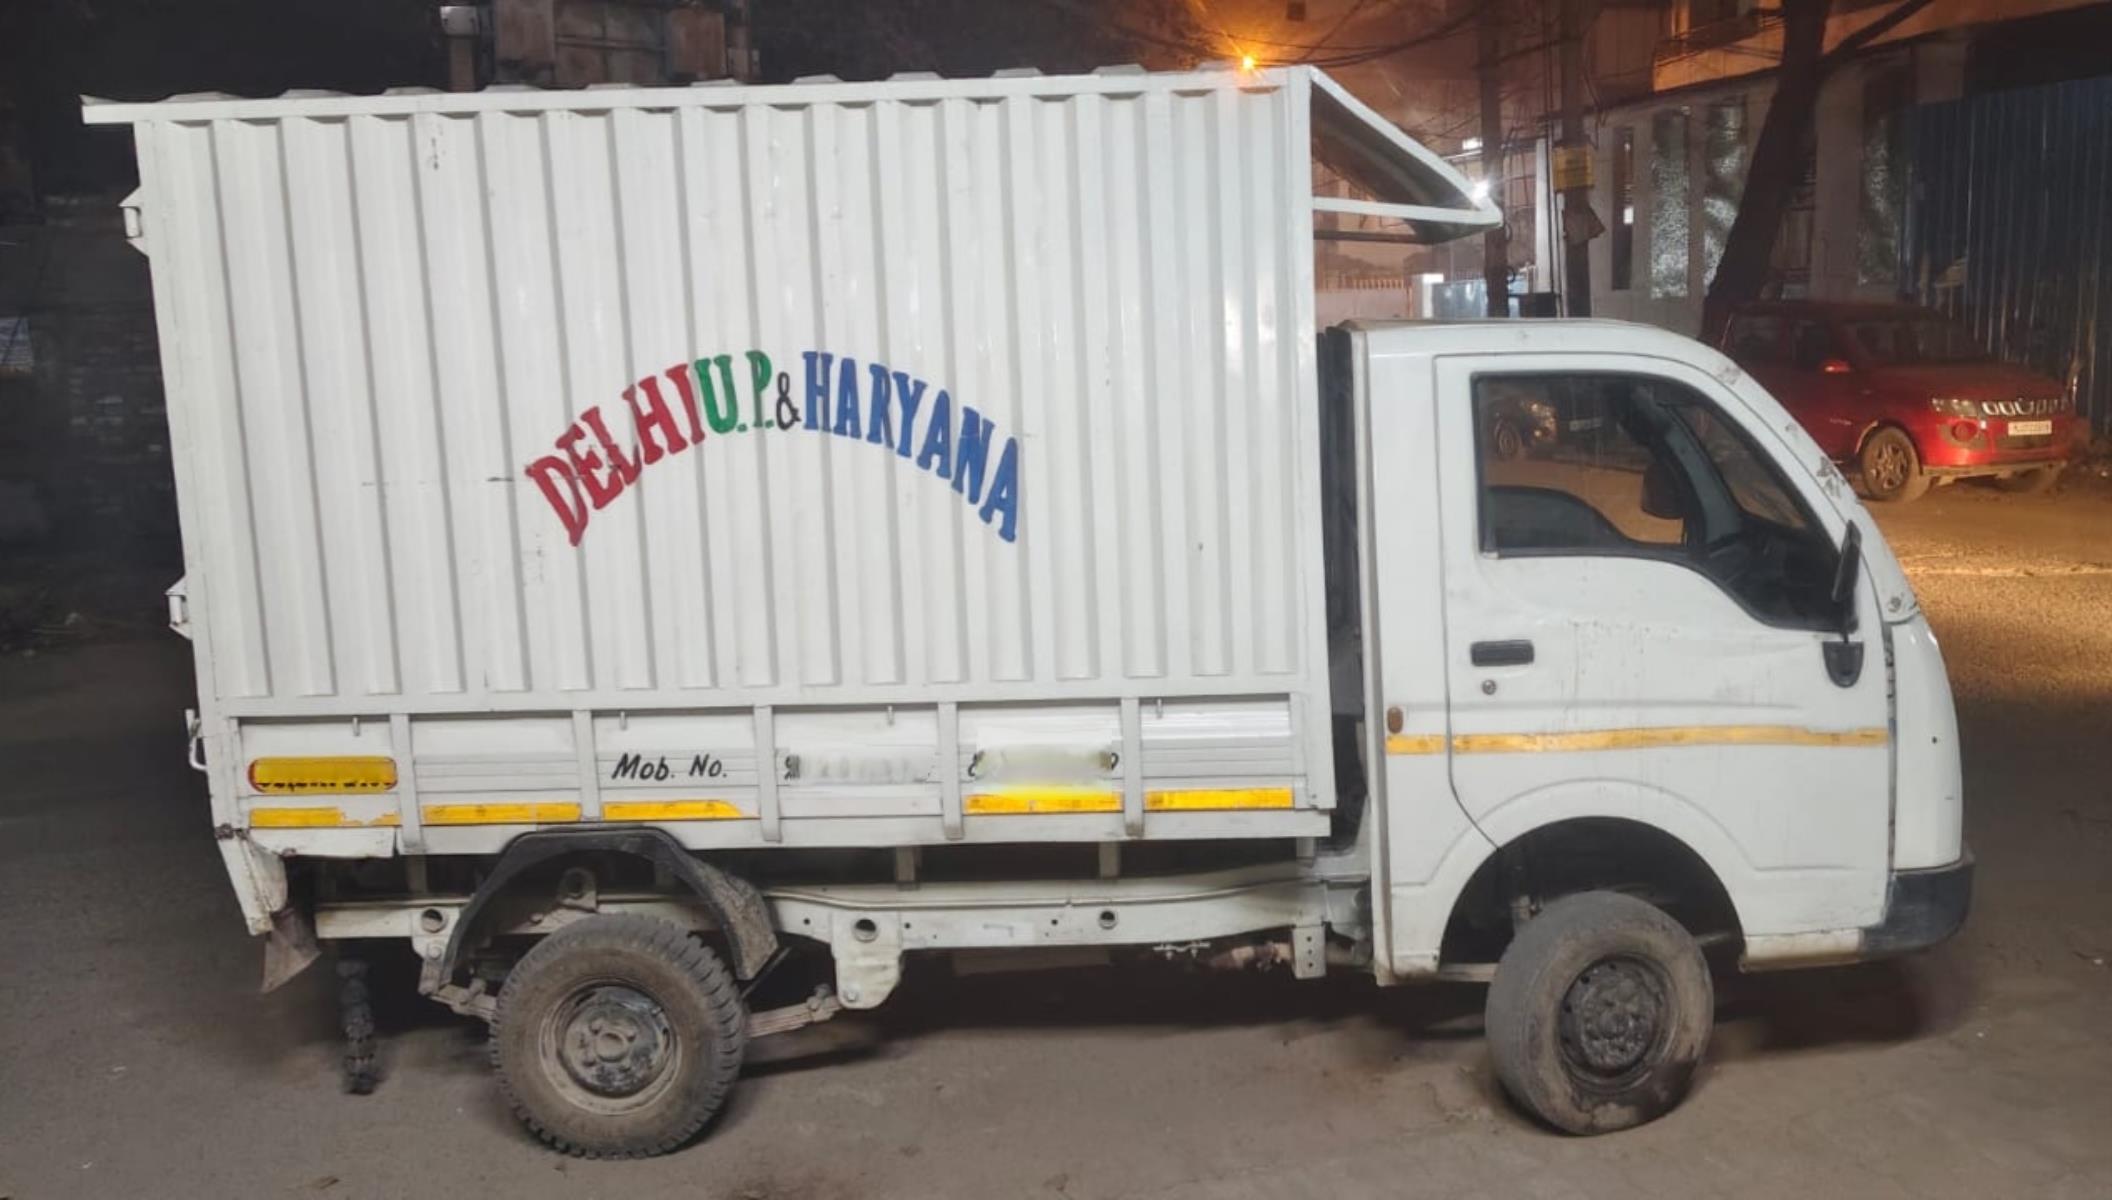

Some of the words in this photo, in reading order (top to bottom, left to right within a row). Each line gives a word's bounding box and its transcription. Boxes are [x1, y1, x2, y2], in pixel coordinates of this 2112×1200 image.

[524, 362, 705, 547] DELHI
[776, 372, 801, 430] &
[802, 351, 1019, 543] HARYANA
[611, 752, 675, 781] Mob.
[688, 753, 728, 778] No.
